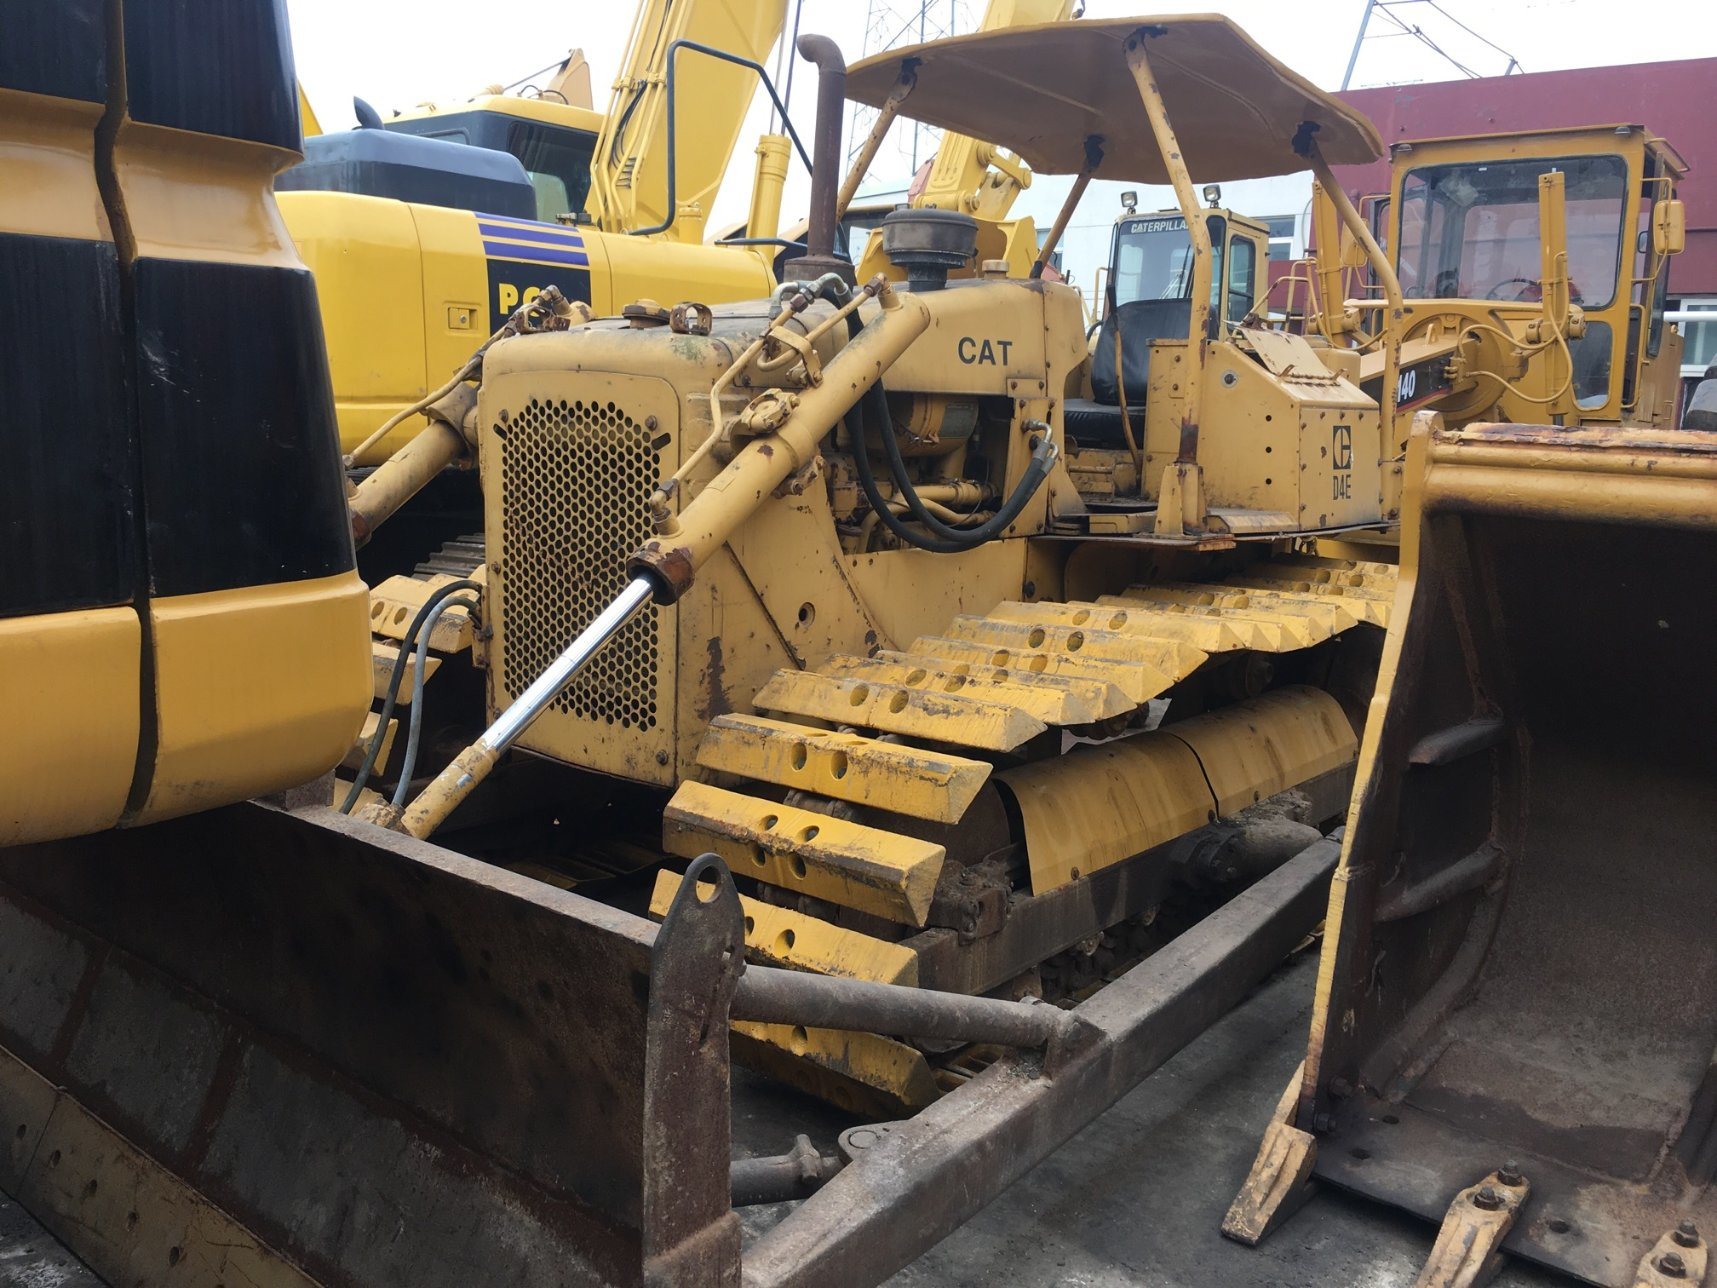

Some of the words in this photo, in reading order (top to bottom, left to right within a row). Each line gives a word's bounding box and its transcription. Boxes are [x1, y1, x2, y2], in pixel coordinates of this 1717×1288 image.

[1131, 219, 1189, 234] CATERPILLA
[958, 336, 1013, 366] CAT
[1397, 369, 1416, 403] 140
[1333, 474, 1351, 501] D4E
